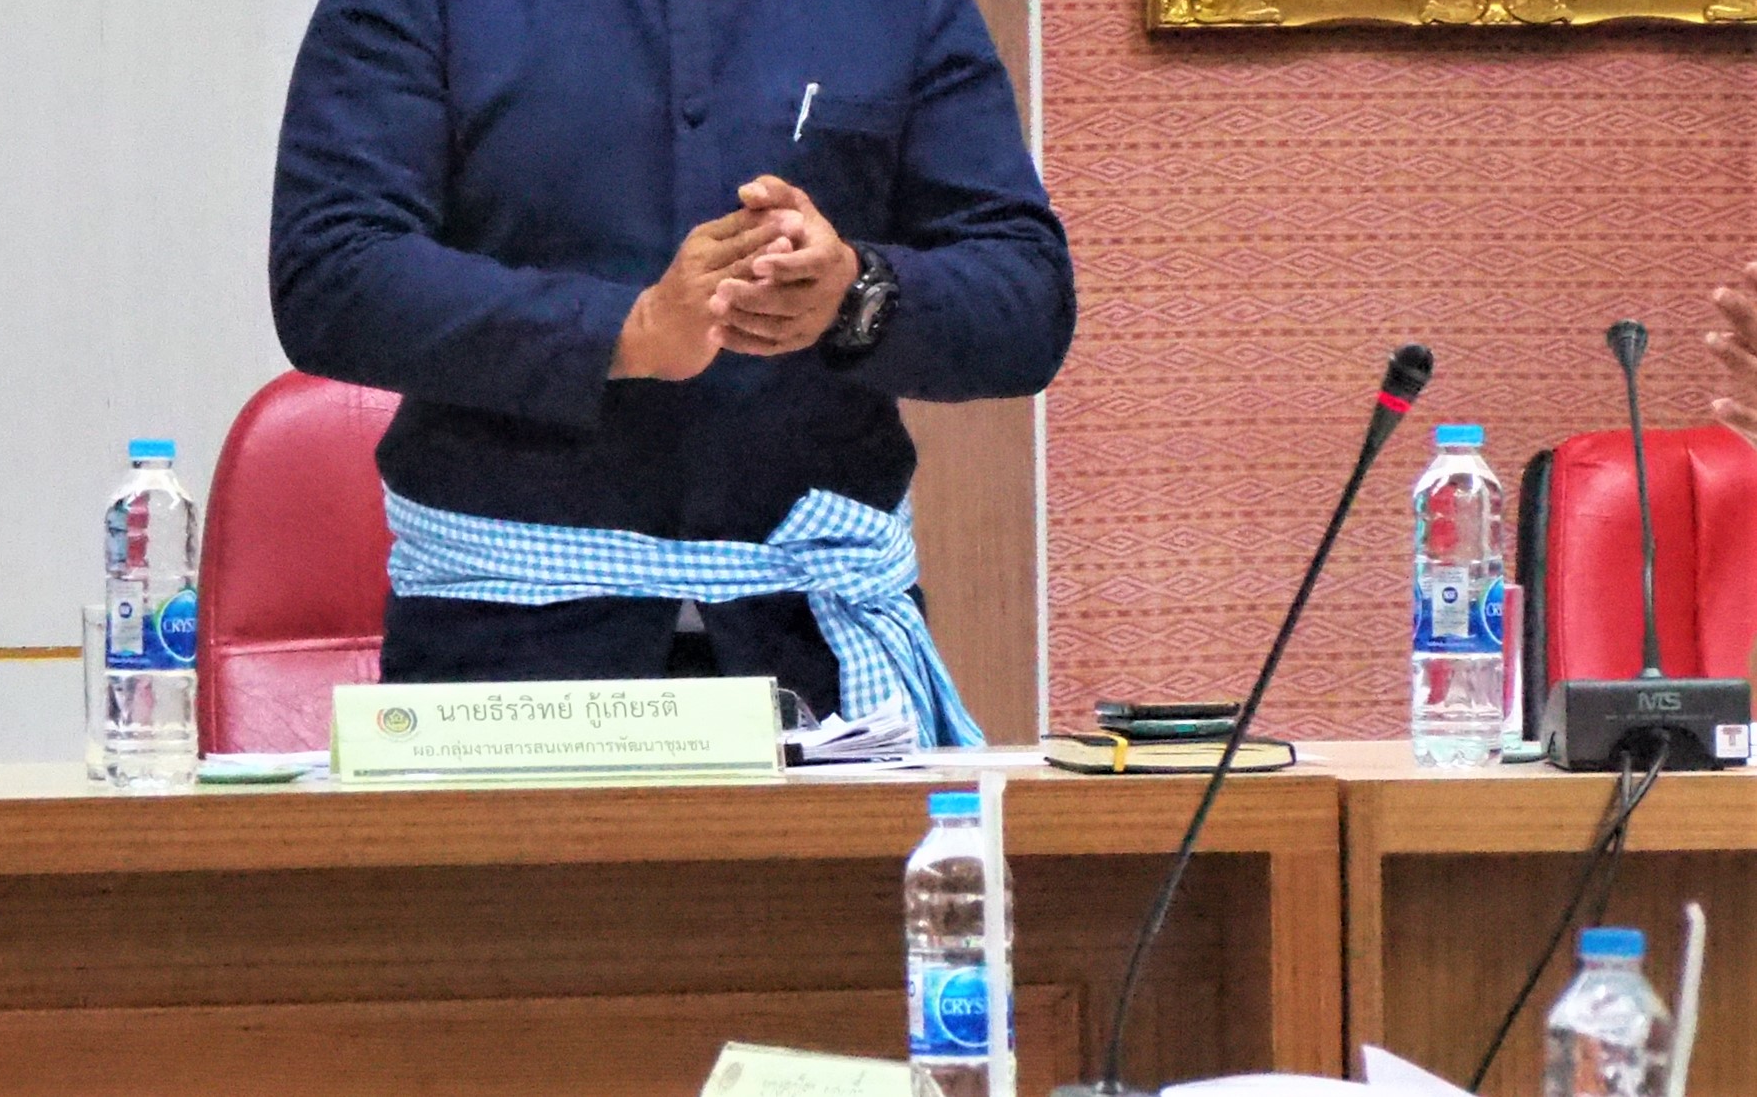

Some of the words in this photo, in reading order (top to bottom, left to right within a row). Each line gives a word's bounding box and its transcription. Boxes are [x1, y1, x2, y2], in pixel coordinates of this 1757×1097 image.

[163, 617, 198, 633] CRYS
[436, 692, 574, 723] นายธีรวิทย์
[585, 690, 679, 729] กู้เกียรติ
[941, 997, 987, 1015] CRYS
